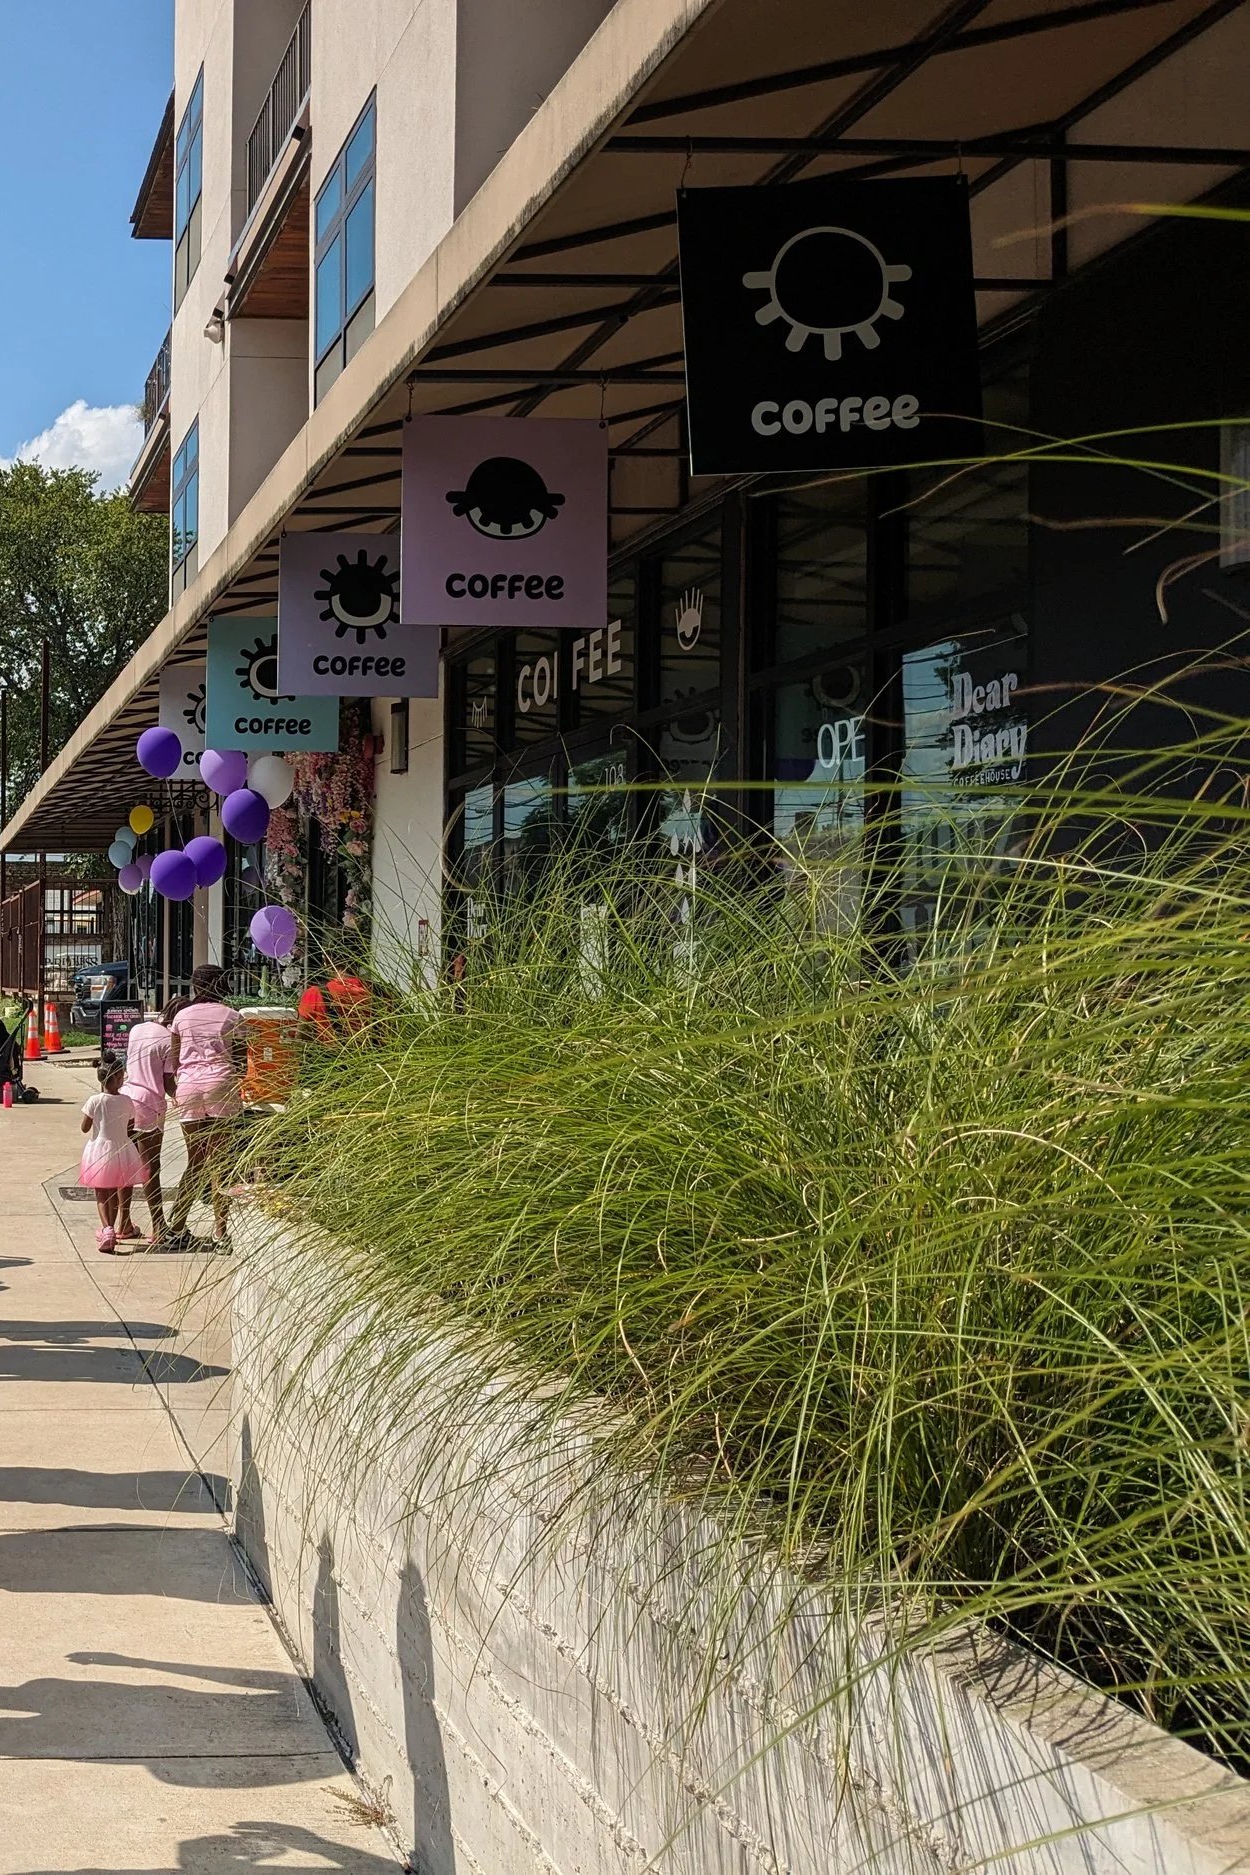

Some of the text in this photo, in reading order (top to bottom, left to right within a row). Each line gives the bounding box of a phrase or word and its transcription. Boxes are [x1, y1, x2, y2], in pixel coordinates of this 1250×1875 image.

[951, 671, 1018, 720] Dear
[817, 715, 866, 769] OPE
[951, 724, 1028, 780] Diary
